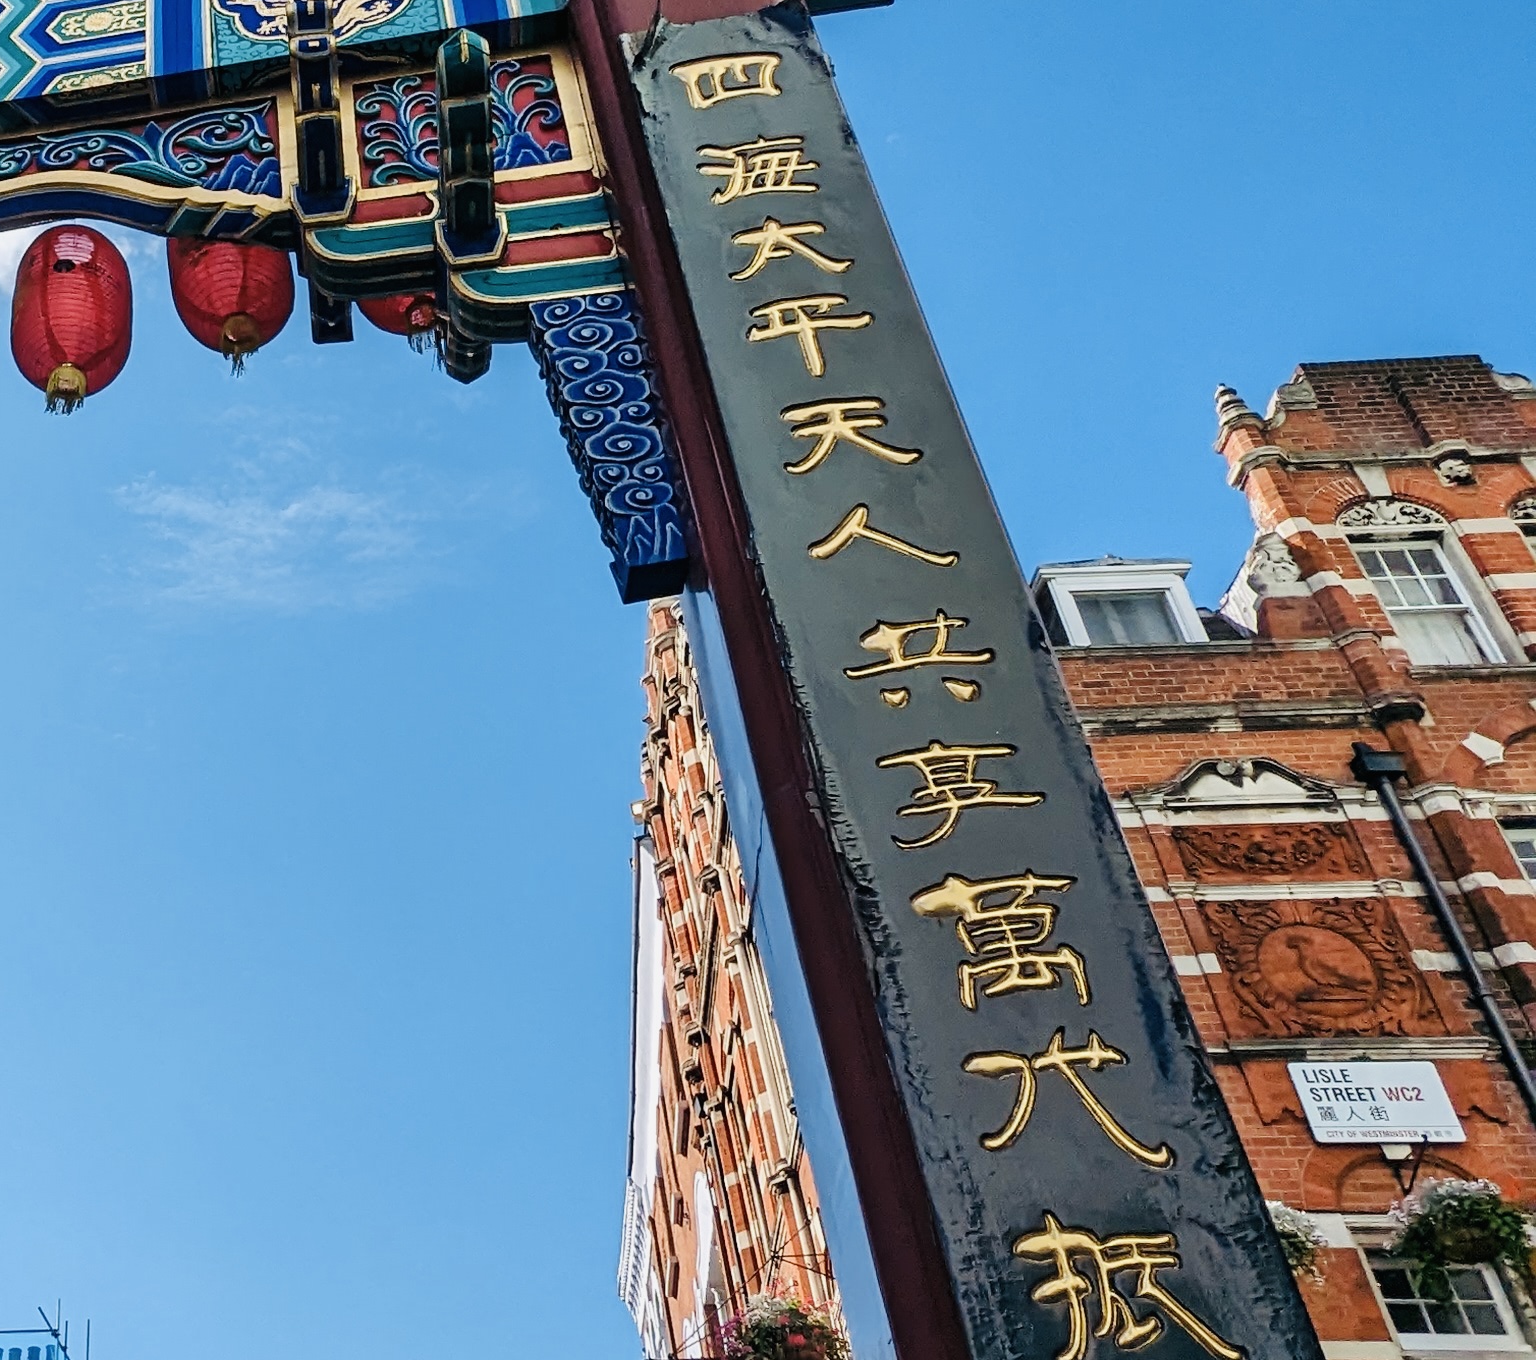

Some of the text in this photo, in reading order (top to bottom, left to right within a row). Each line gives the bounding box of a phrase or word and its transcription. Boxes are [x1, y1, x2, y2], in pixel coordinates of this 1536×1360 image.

[1301, 1069, 1352, 1083] LISLE
[1309, 1087, 1425, 1102] STREET WC2
[1326, 1130, 1345, 1138] CITY
[1347, 1130, 1358, 1138] OF
[1360, 1130, 1420, 1139] WESTMINSTER
